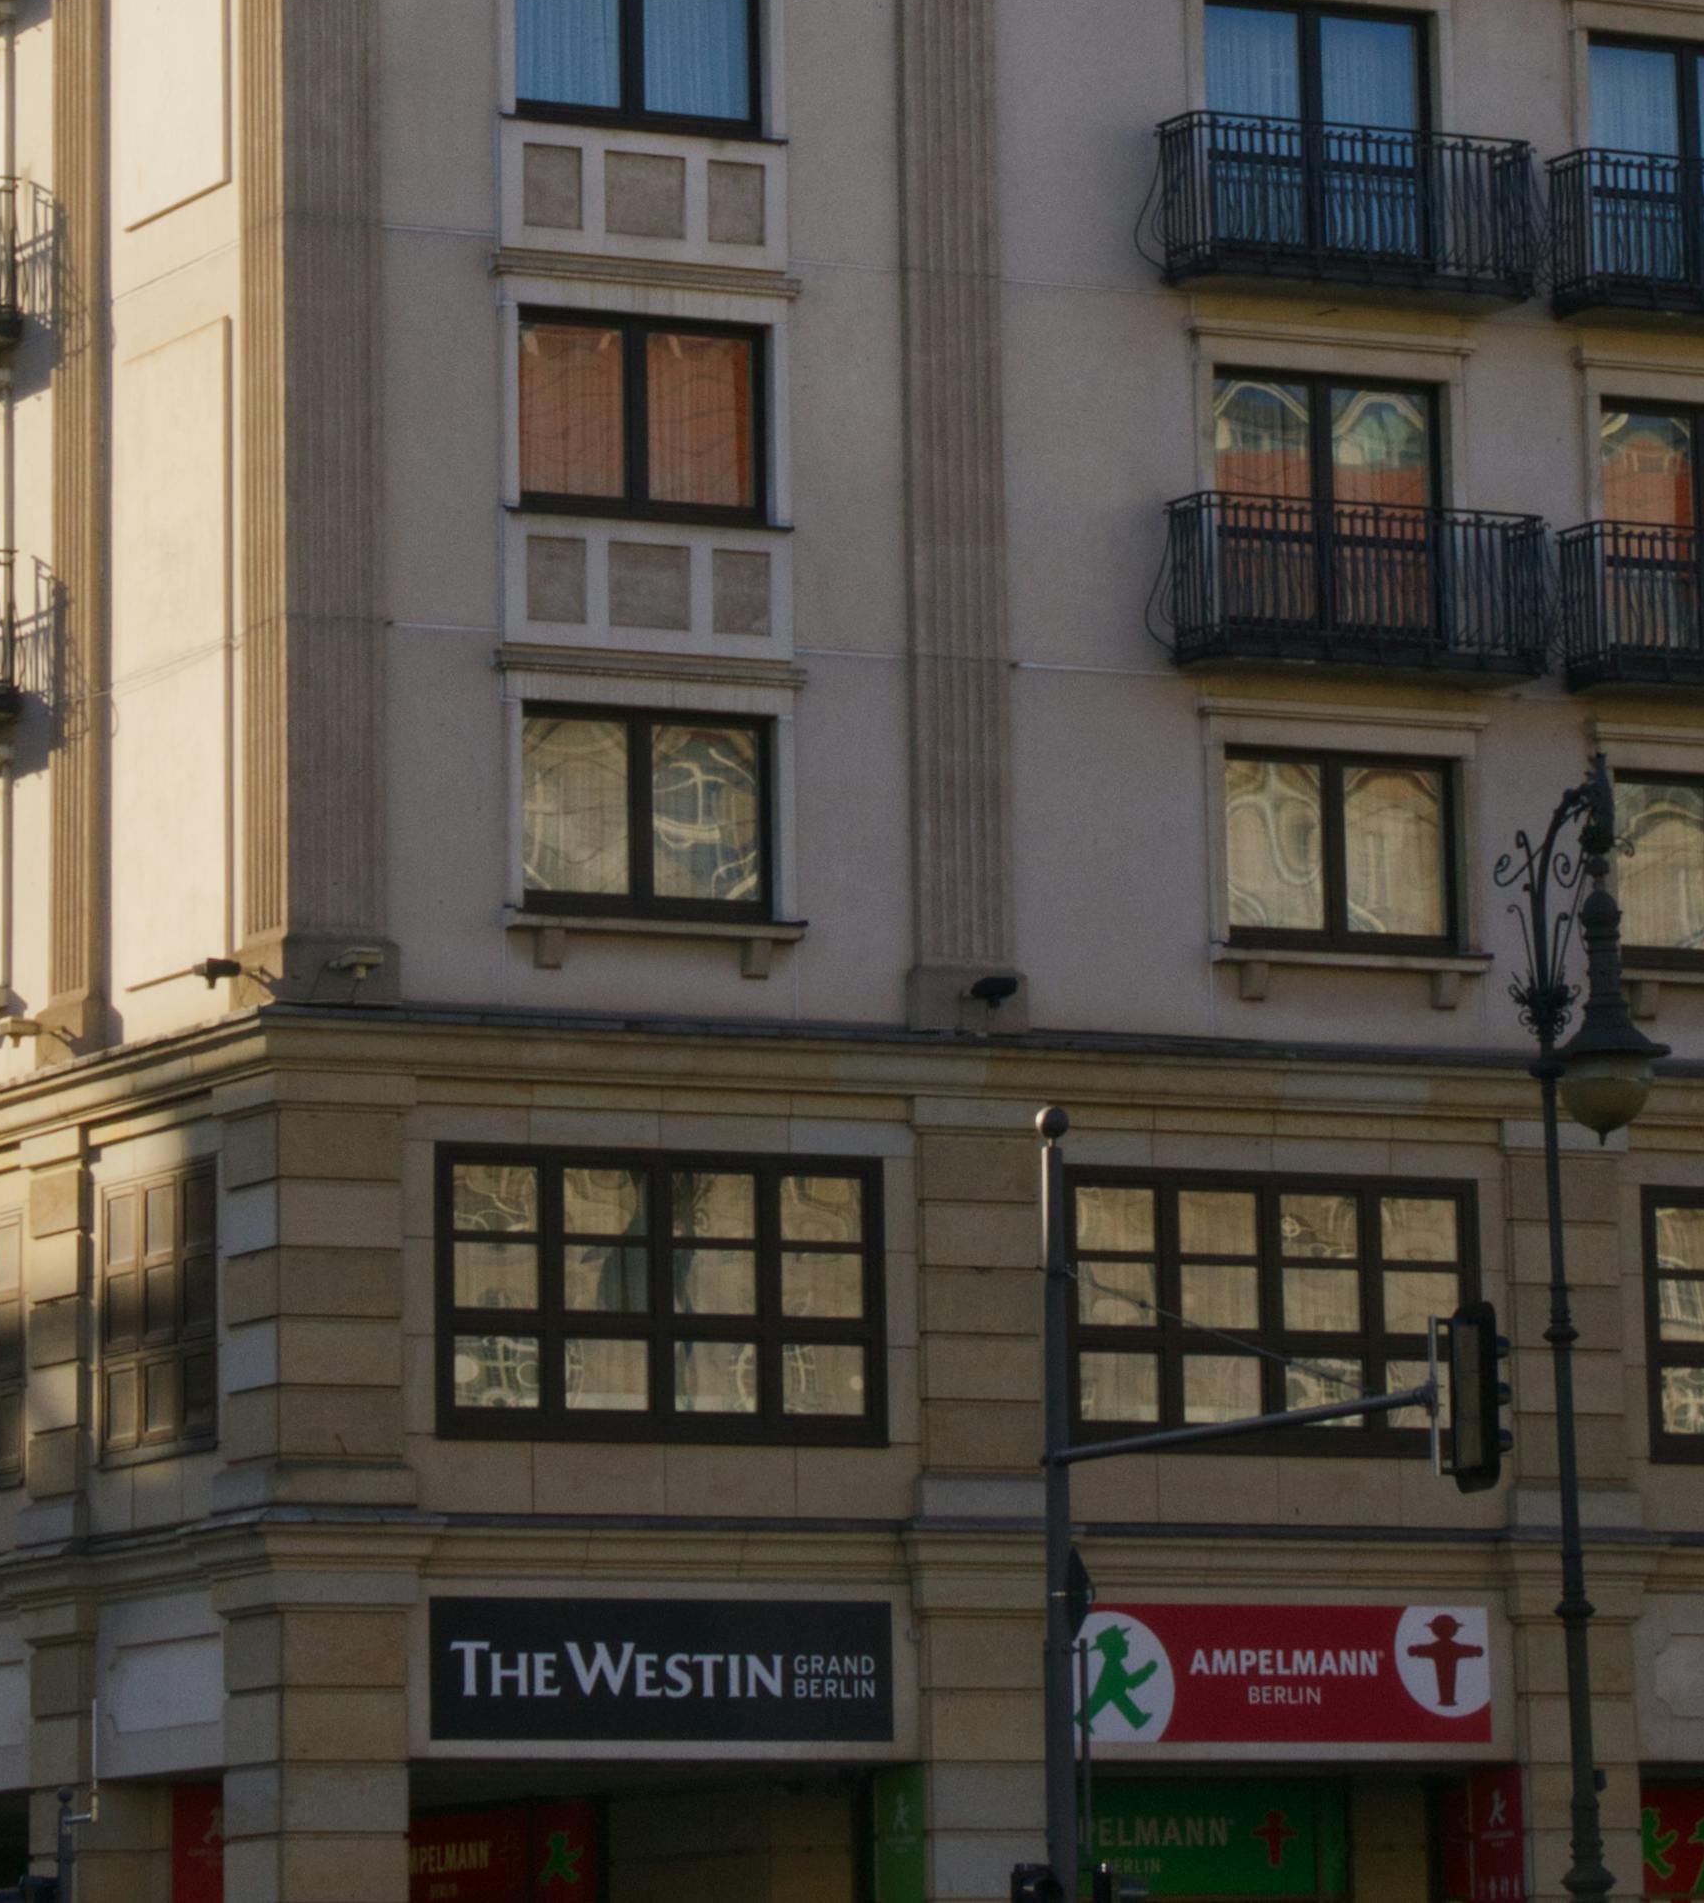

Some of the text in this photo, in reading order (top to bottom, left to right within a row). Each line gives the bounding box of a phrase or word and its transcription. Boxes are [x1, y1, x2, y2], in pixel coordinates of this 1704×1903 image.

[449, 1640, 783, 1698] THE WESTIN
[793, 1654, 876, 1676] GRAND
[1189, 1649, 1379, 1676] AMPELMANN
[793, 1679, 876, 1699] BERLIN
[1247, 1685, 1322, 1705] BERLIN
